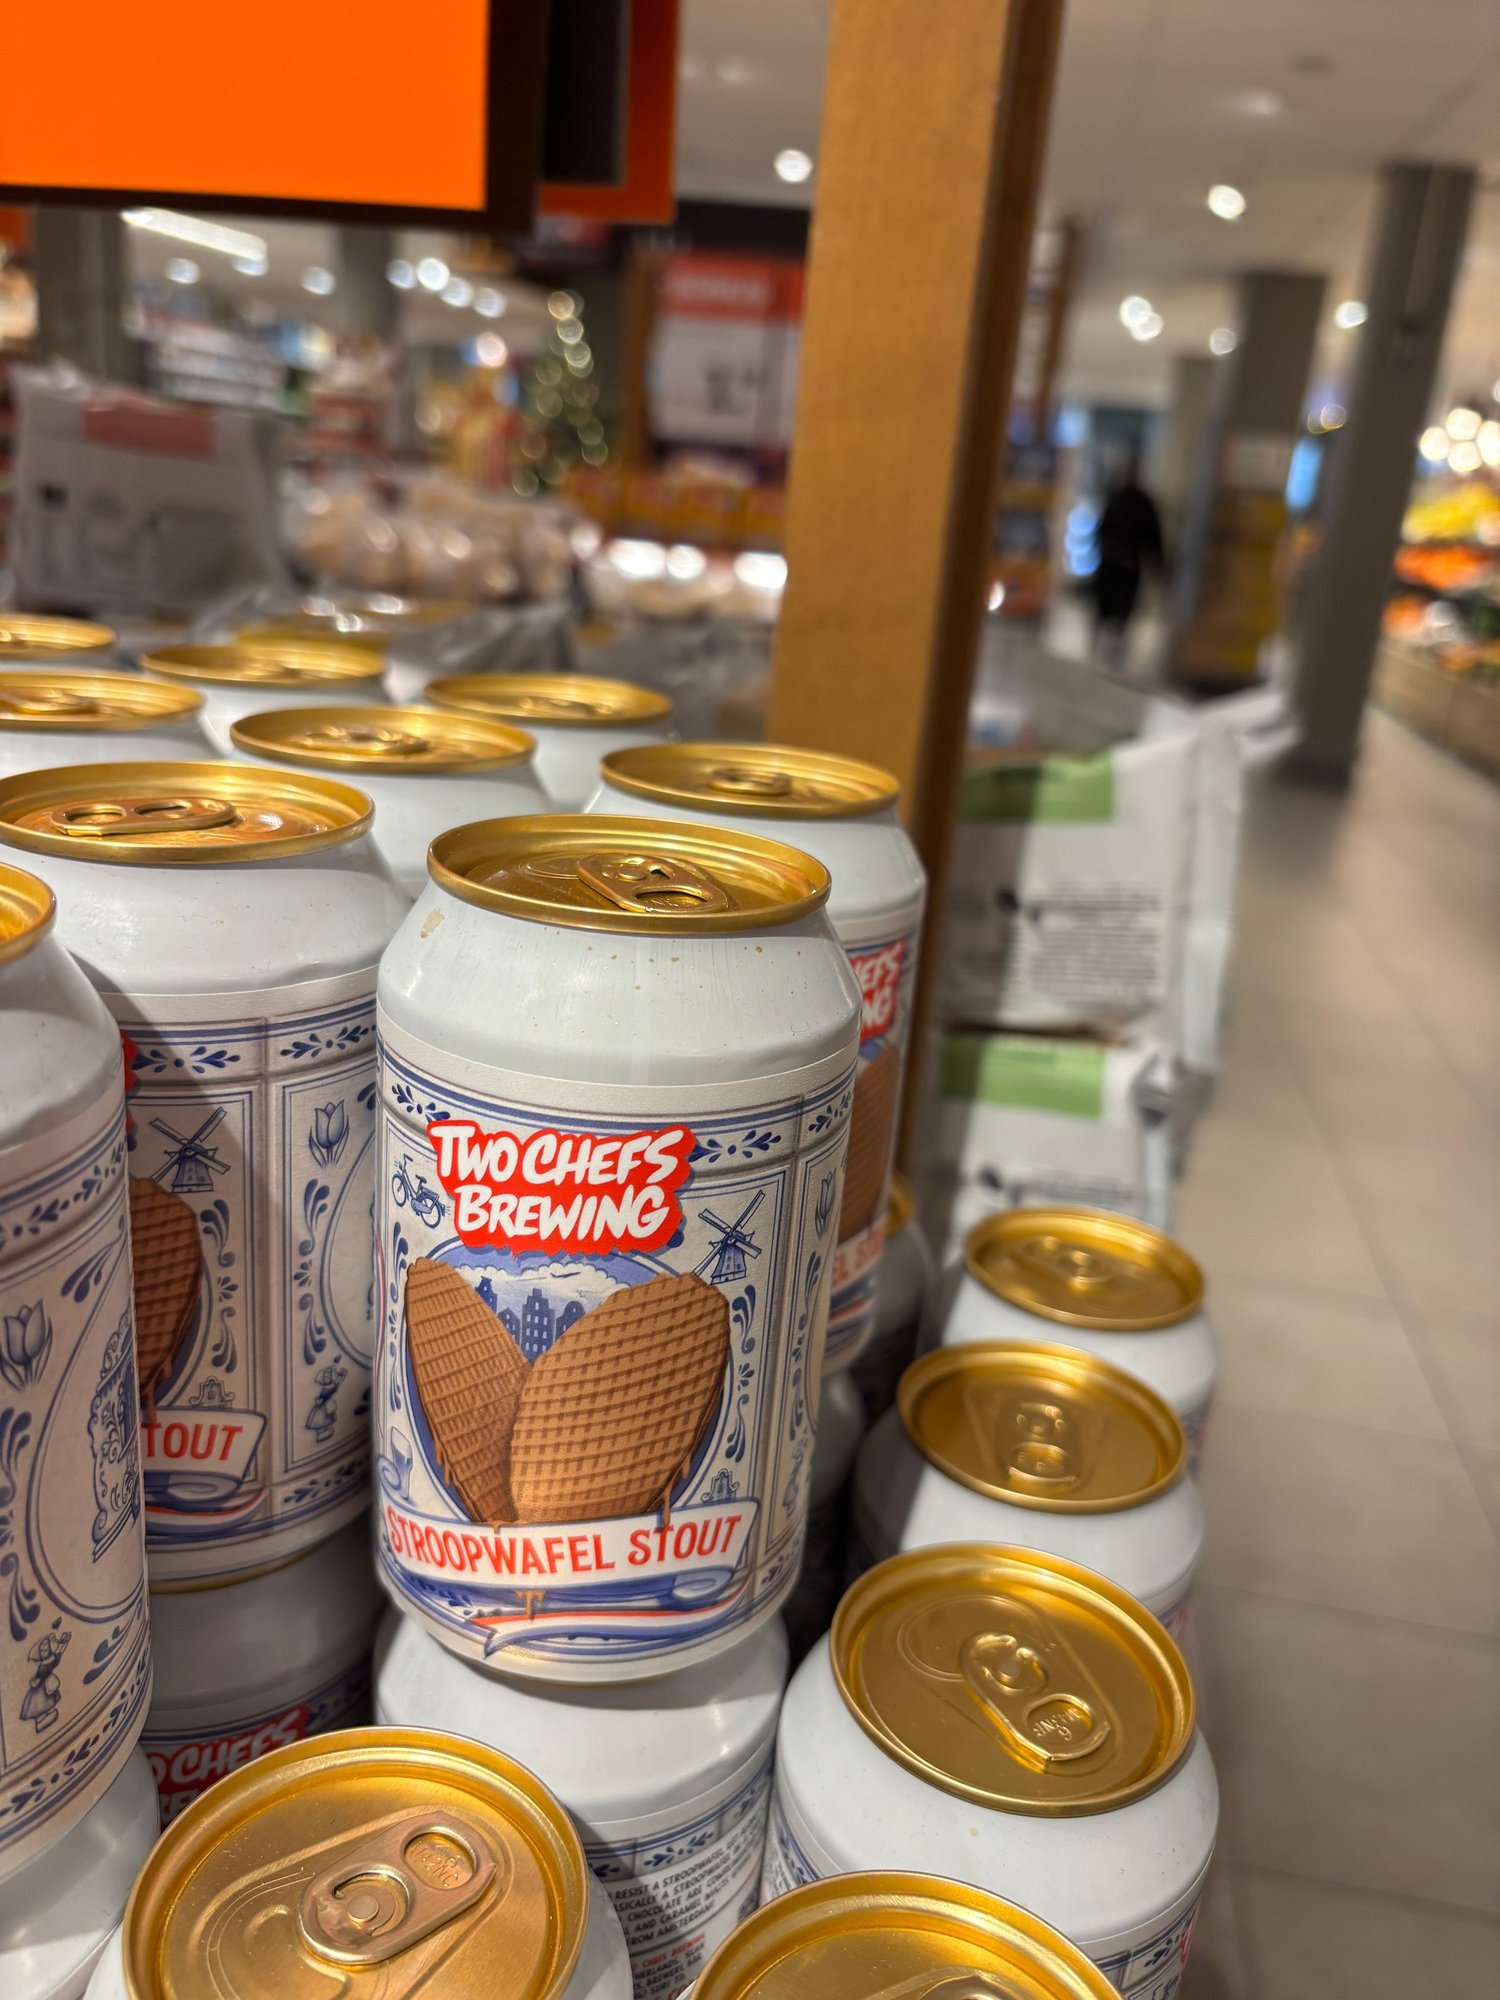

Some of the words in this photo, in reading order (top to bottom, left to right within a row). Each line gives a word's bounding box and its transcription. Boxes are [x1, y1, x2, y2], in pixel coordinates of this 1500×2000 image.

[430, 1126, 519, 1182] TWO
[522, 1129, 684, 1186] CHEFS
[453, 1184, 670, 1241] BREWING
[141, 1421, 243, 1461] TOUT
[386, 1505, 616, 1575] STROOPWAFEL
[628, 1514, 742, 1566] STOUT
[170, 1709, 300, 1784] CHEFS
[634, 1919, 657, 1933] AND
